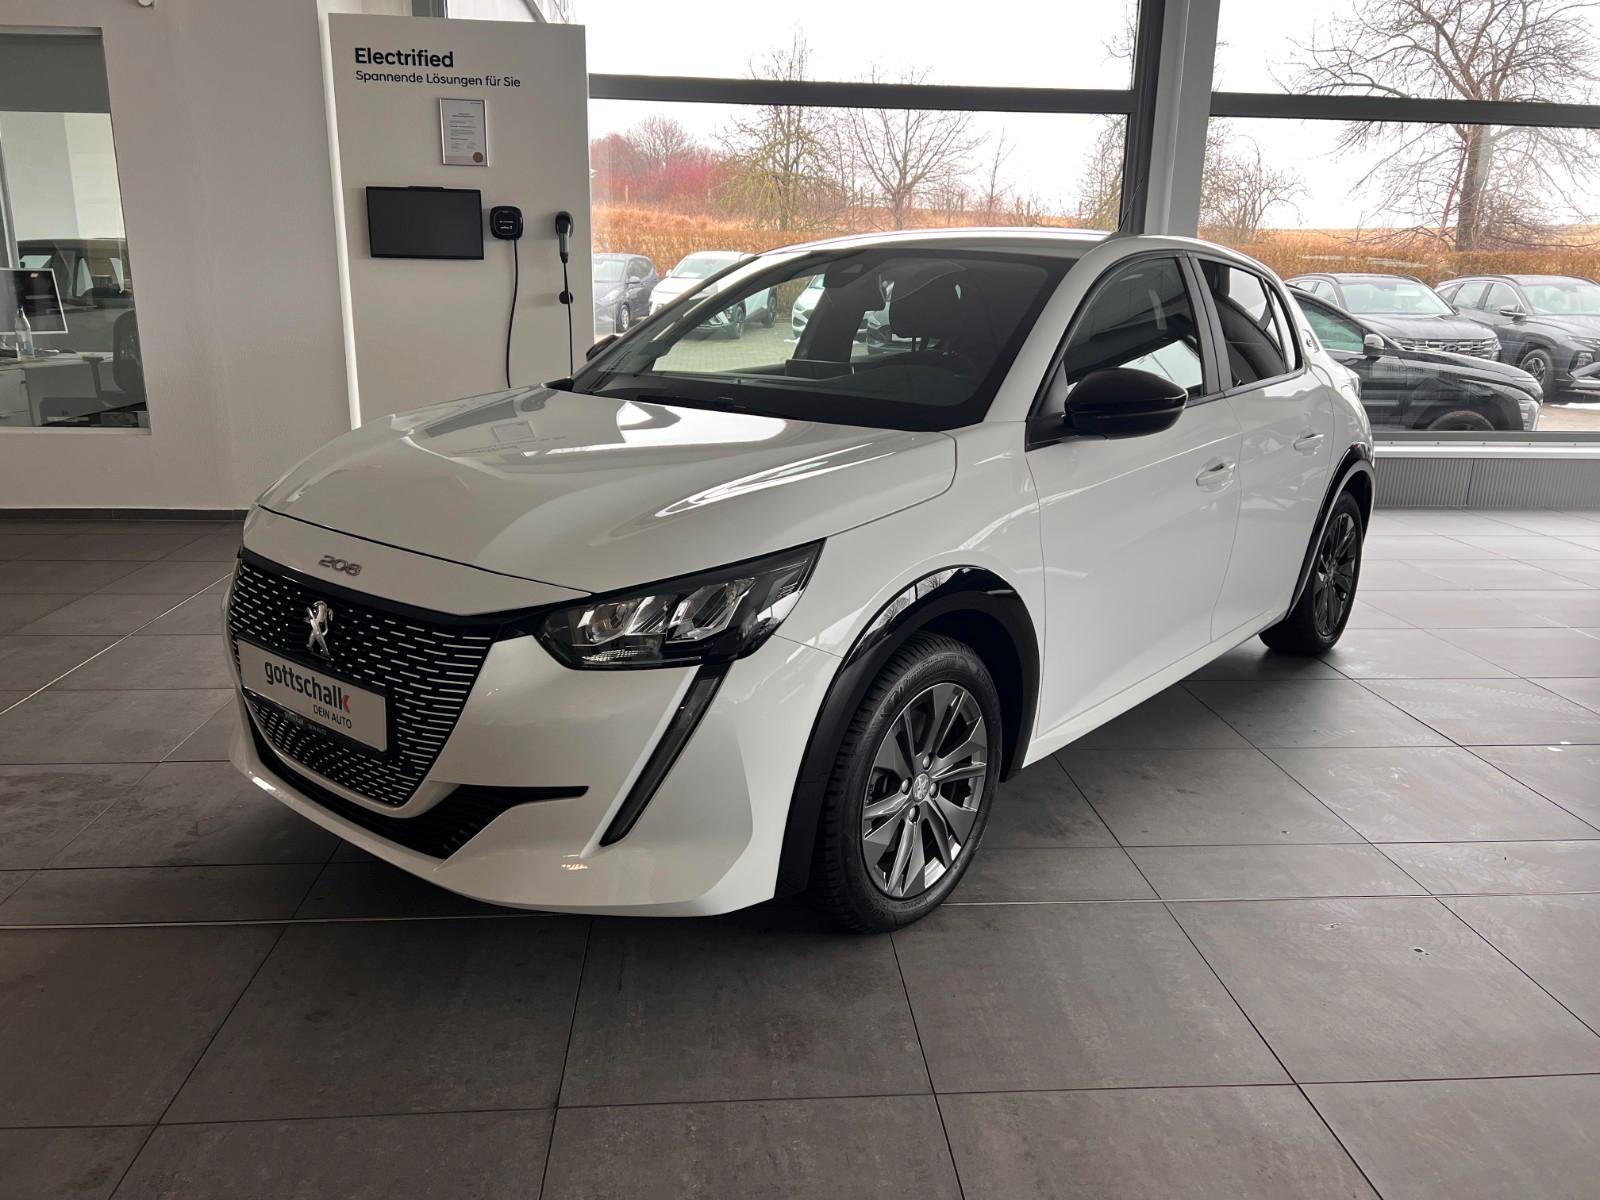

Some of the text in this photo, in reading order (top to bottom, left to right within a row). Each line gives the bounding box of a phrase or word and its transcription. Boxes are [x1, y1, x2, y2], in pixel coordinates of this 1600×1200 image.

[355, 47, 453, 68] Electrified
[355, 70, 521, 87] Spannende Lösungen für Sie
[264, 662, 351, 713] gottschalk
[313, 704, 330, 720] DEIN
[332, 713, 352, 729] AUTO
